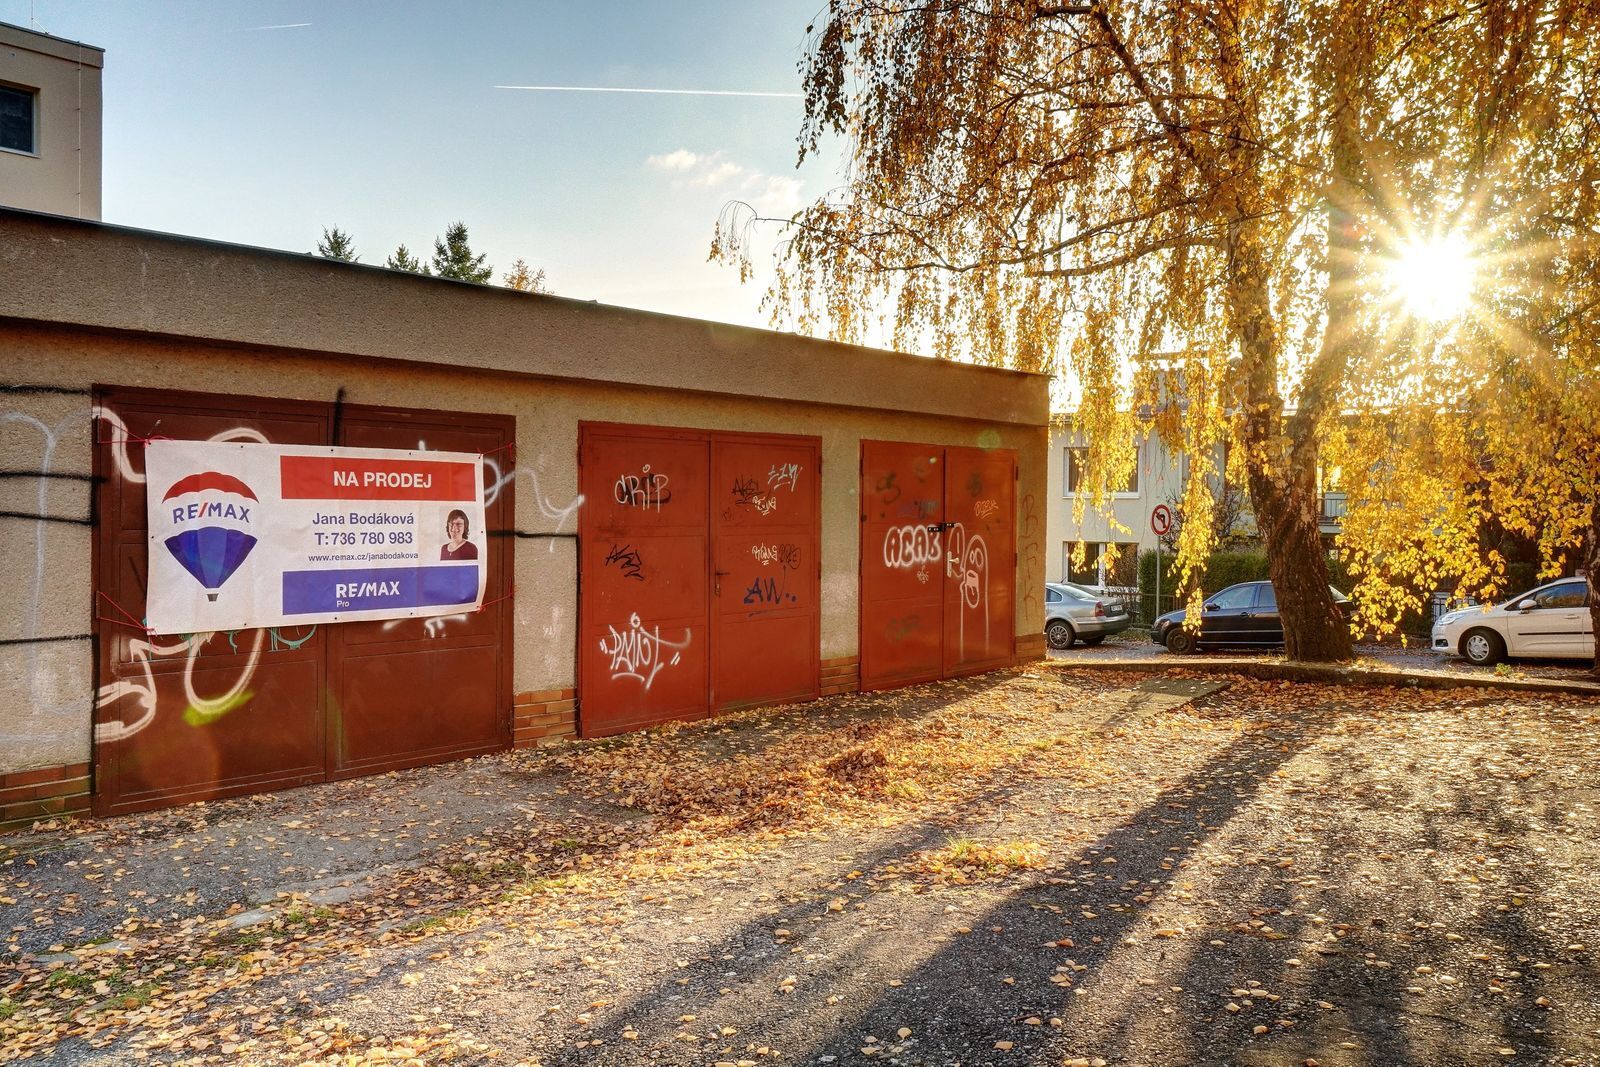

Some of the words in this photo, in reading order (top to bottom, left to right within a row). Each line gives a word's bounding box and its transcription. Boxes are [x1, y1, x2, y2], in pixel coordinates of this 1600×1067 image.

[333, 471, 359, 487] NA
[363, 471, 432, 489] PRODEJ
[172, 502, 251, 524] RE/MAX
[312, 512, 345, 525] Jana
[349, 512, 414, 525] Bodáková
[360, 531, 385, 545] 780
[388, 531, 413, 545] 983
[308, 552, 419, 562] www.remax.cz/janabodakova
[335, 580, 401, 599] RE/MAX
[336, 600, 350, 608] Pro
